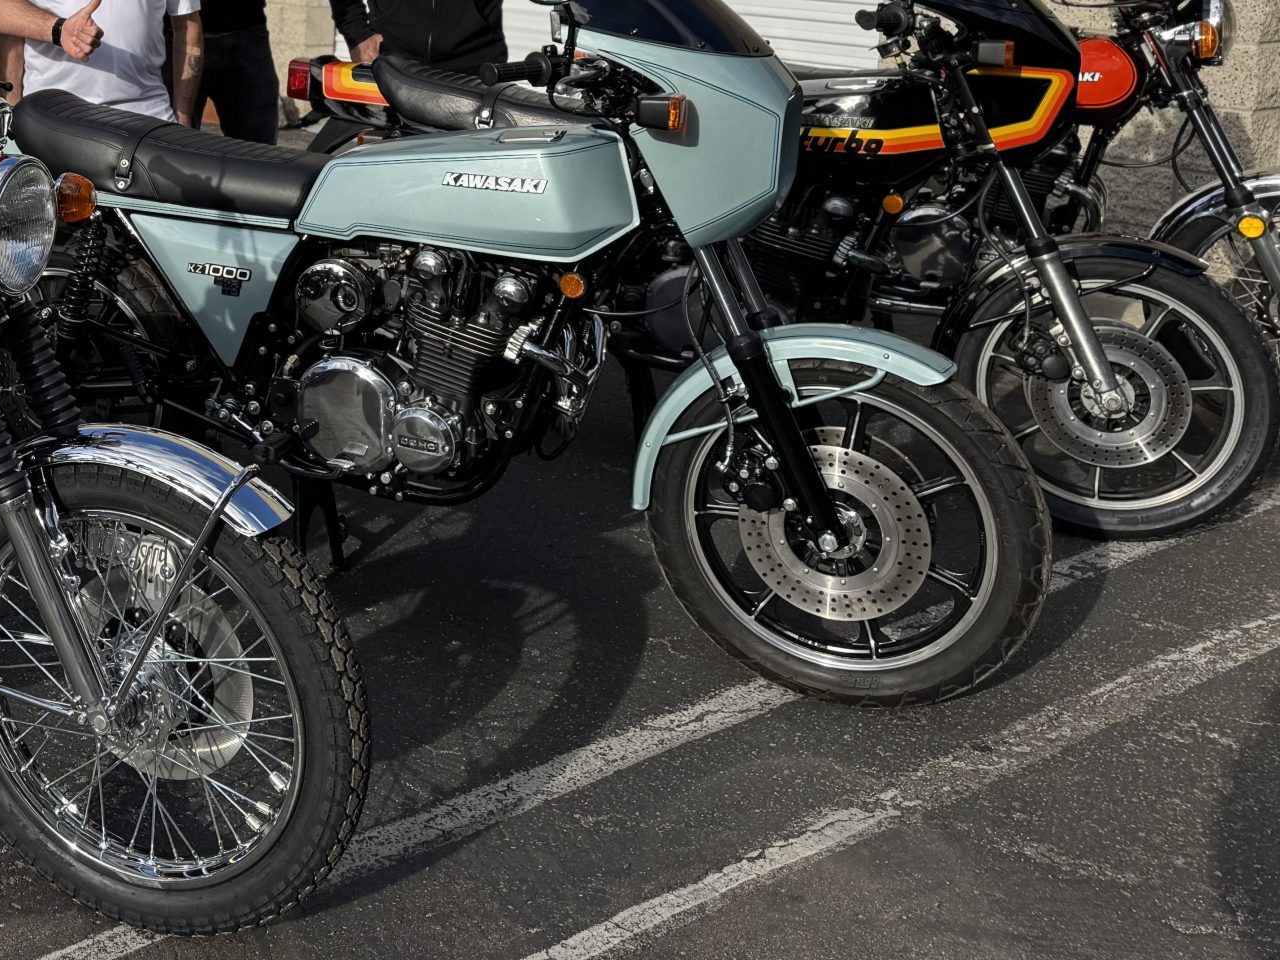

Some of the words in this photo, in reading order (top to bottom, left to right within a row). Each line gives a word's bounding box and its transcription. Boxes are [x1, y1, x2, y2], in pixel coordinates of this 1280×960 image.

[800, 126, 884, 155] turbo
[442, 171, 548, 194] KAWASAKI
[187, 263, 251, 281] KZ1000
